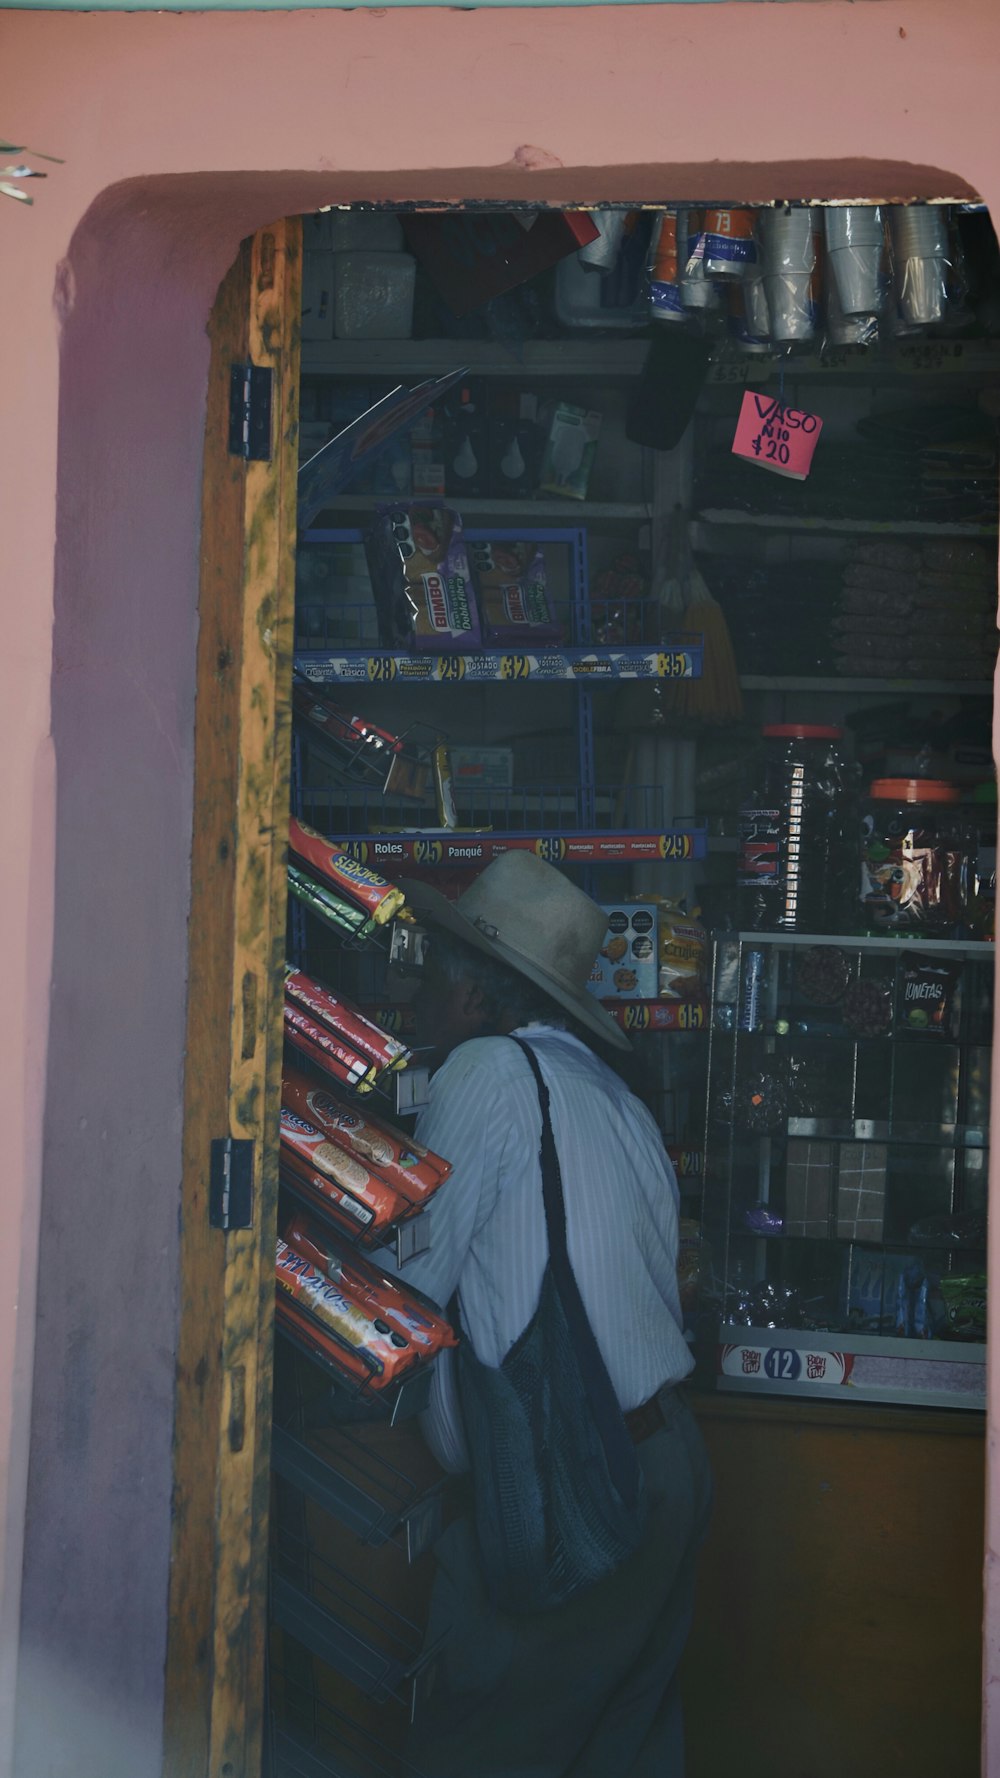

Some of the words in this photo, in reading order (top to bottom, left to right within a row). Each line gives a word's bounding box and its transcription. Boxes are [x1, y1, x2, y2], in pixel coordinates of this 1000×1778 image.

[716, 212, 731, 233] 73
[754, 395, 818, 433] VASO
[751, 434, 790, 464] $20
[428, 576, 448, 628] BIMBO
[374, 843, 403, 854] Roles
[448, 845, 482, 857] Panqué
[334, 855, 387, 886] CRACKETS
[904, 981, 943, 1001] LUNETAS
